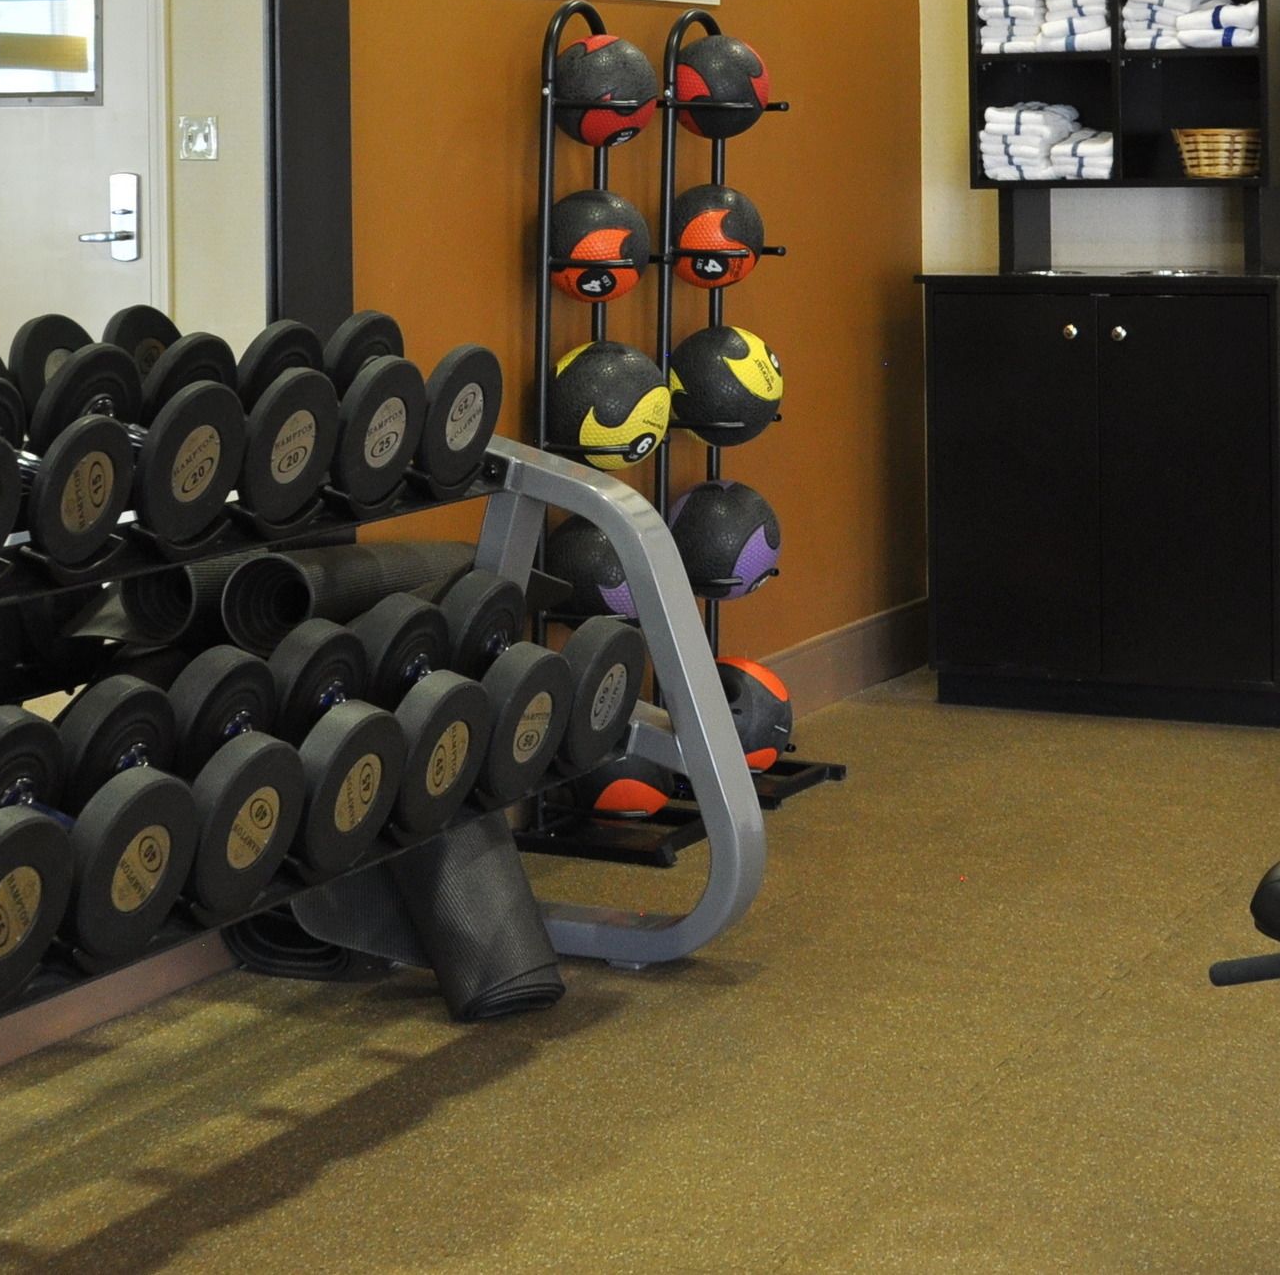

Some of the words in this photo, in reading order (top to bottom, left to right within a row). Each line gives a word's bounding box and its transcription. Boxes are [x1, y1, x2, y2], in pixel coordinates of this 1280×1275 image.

[704, 258, 723, 273] 4
[581, 279, 602, 293] 4
[457, 398, 468, 415] 25
[378, 437, 391, 453] 25
[636, 437, 653, 454] 6
[286, 451, 300, 468] 20
[91, 474, 102, 494] 15
[190, 466, 205, 485] 20
